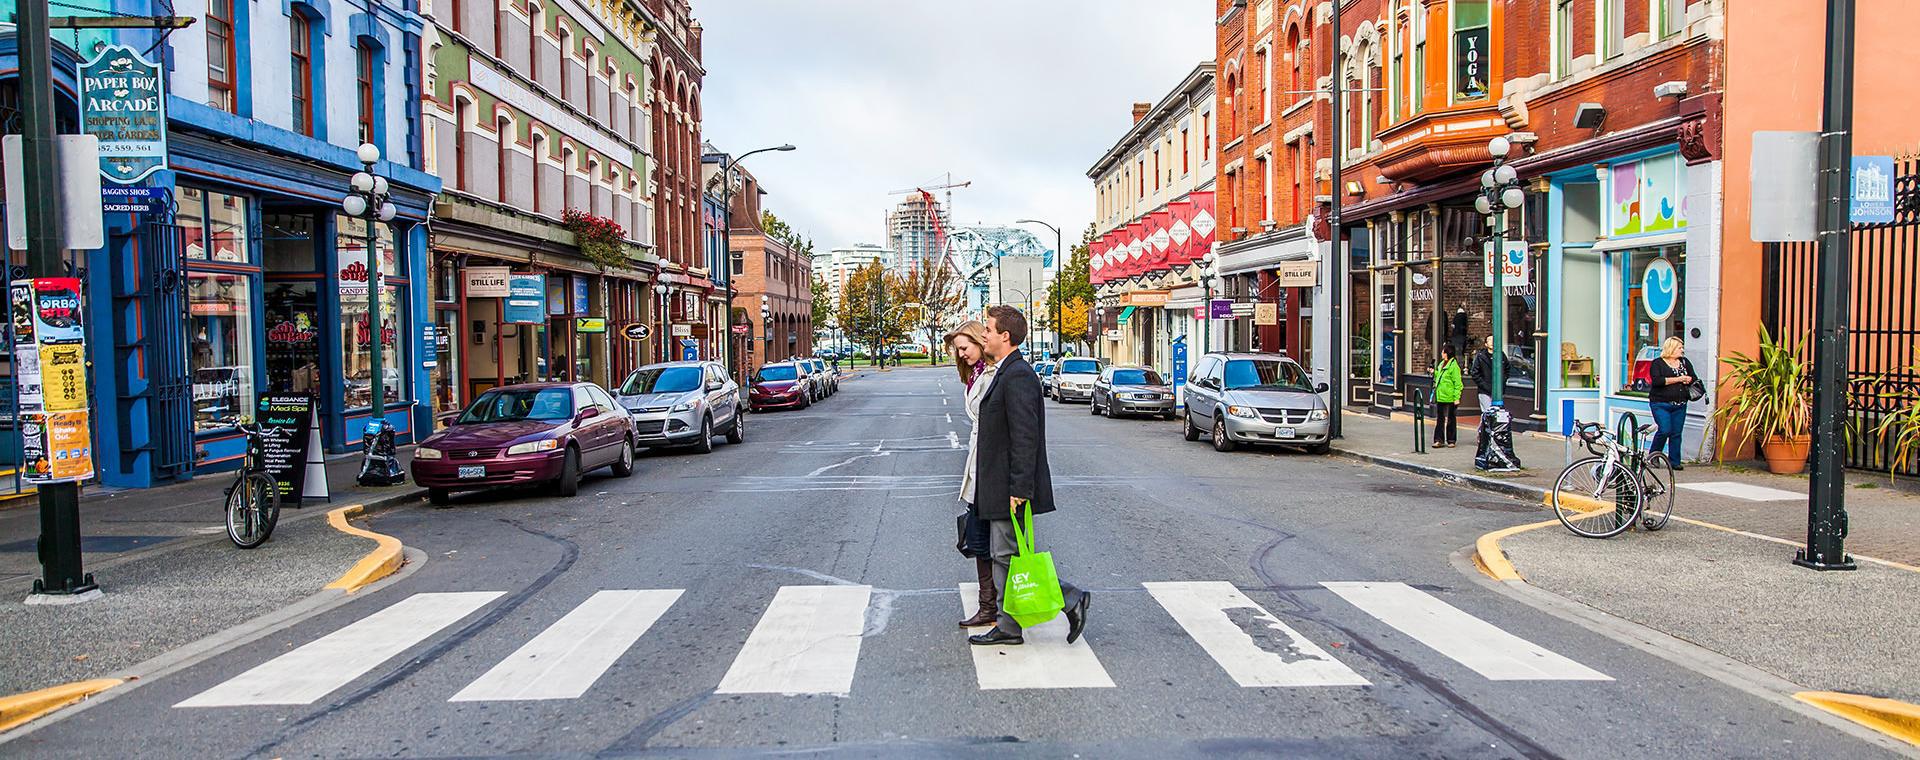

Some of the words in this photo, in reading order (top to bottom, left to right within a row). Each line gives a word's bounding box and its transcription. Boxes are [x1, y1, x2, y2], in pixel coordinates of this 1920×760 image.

[1467, 36, 1478, 89] YOGA
[84, 77, 128, 92] PAPER
[132, 76, 157, 92] BOX
[87, 96, 159, 112] ARCADE
[88, 116, 130, 126] SHOPPING
[134, 116, 156, 126] LA
[102, 188, 129, 196] BAGGINS
[130, 188, 150, 196] SHOES
[104, 204, 131, 212] SACRED
[131, 204, 150, 212] HERB
[1853, 208, 1893, 216] JOHNSON
[1488, 251, 1508, 263] hp
[1488, 263, 1522, 277] bby
[340, 268, 383, 283] sugr
[674, 325, 689, 333] Bliss
[687, 352, 694, 360] P
[1177, 347, 1183, 355] P
